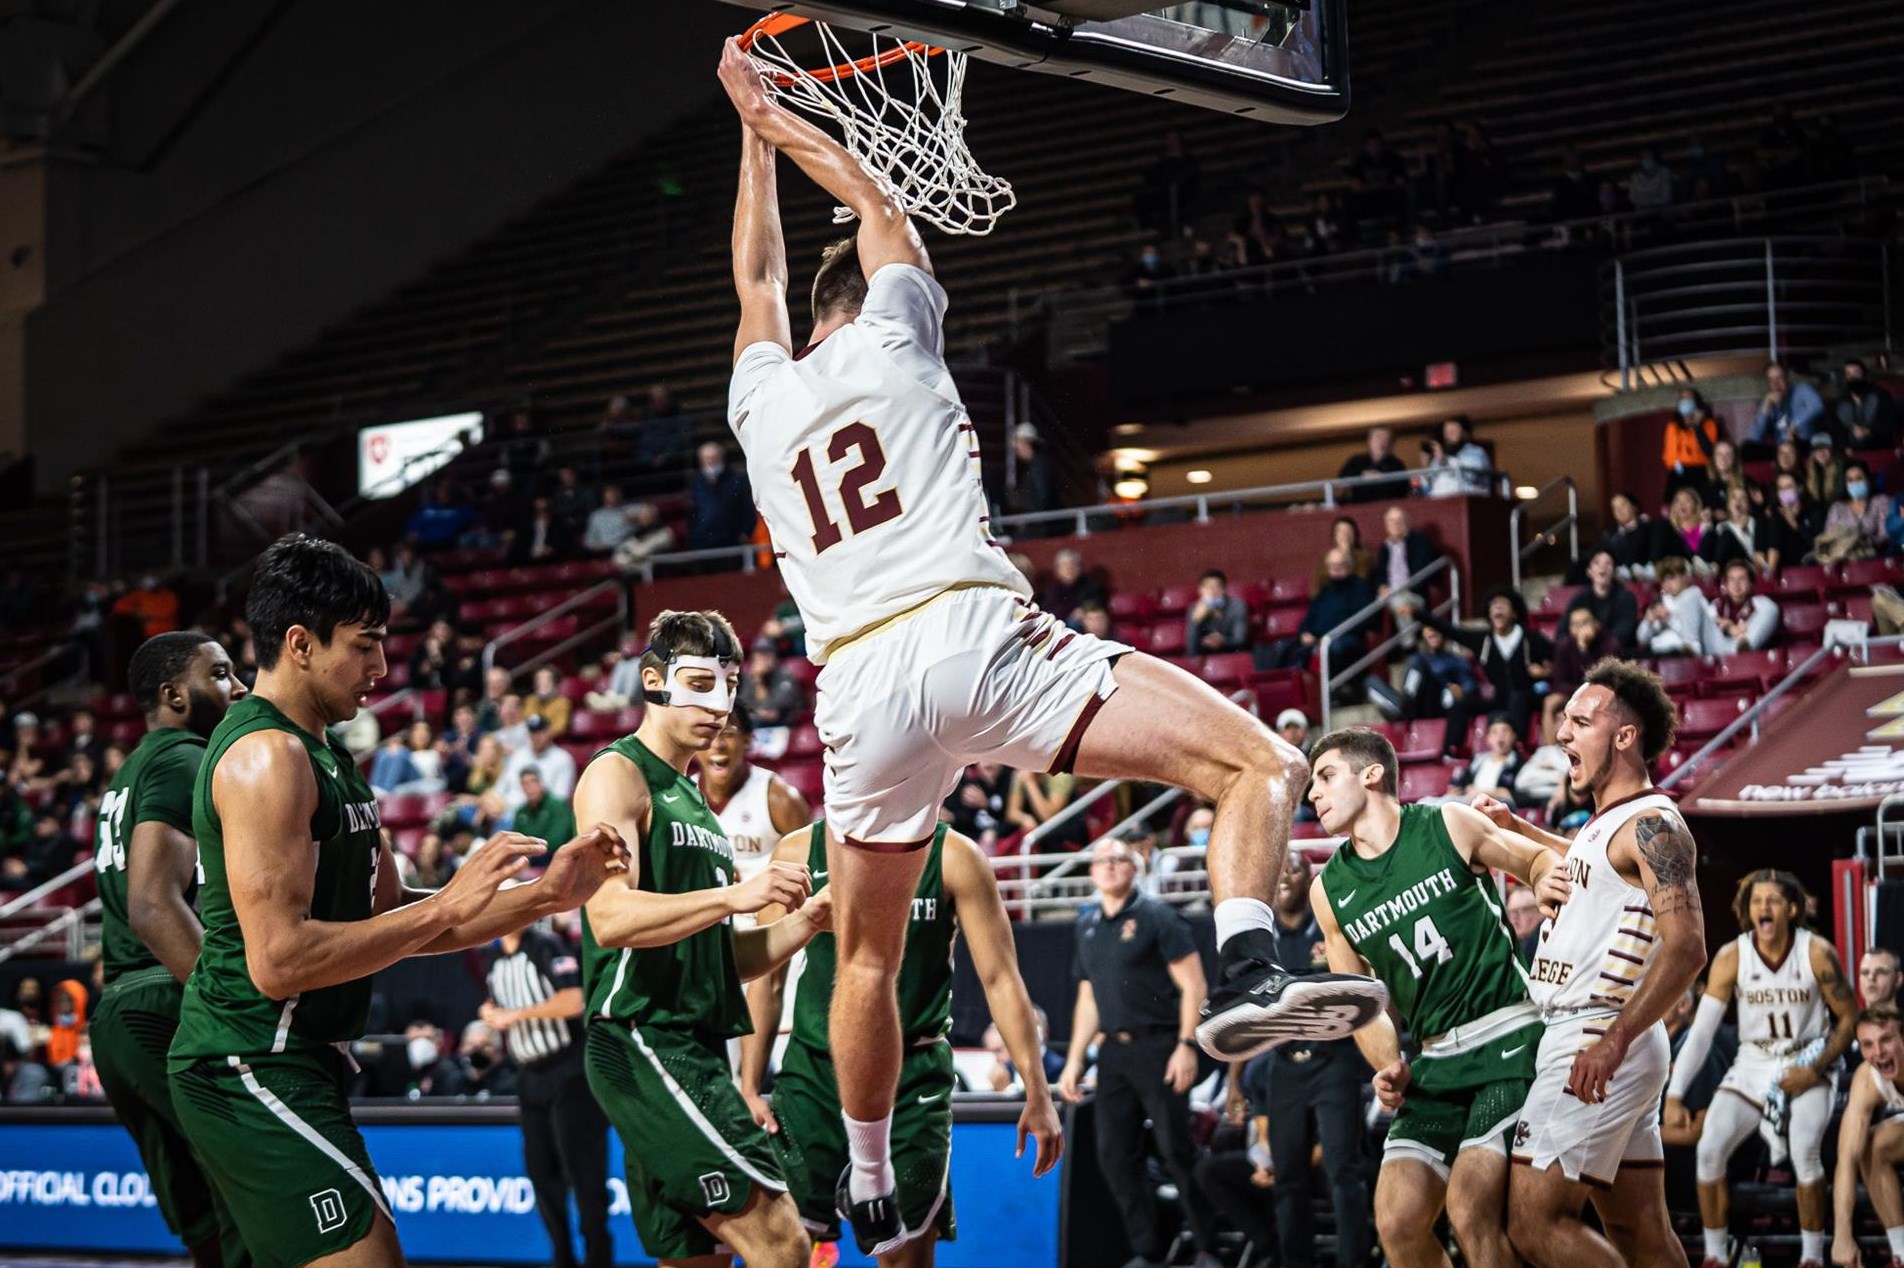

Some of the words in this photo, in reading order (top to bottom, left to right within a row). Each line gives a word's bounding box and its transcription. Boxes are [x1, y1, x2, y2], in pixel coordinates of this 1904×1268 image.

[790, 420, 904, 556] 12
[911, 897, 938, 921] TH
[1344, 868, 1458, 944] DARTMOUTH
[1388, 914, 1454, 979] 14
[1746, 987, 1812, 1005] BOSTON
[1767, 1011, 1794, 1039] 11
[699, 1171, 730, 1207] D
[309, 1188, 348, 1234] D
